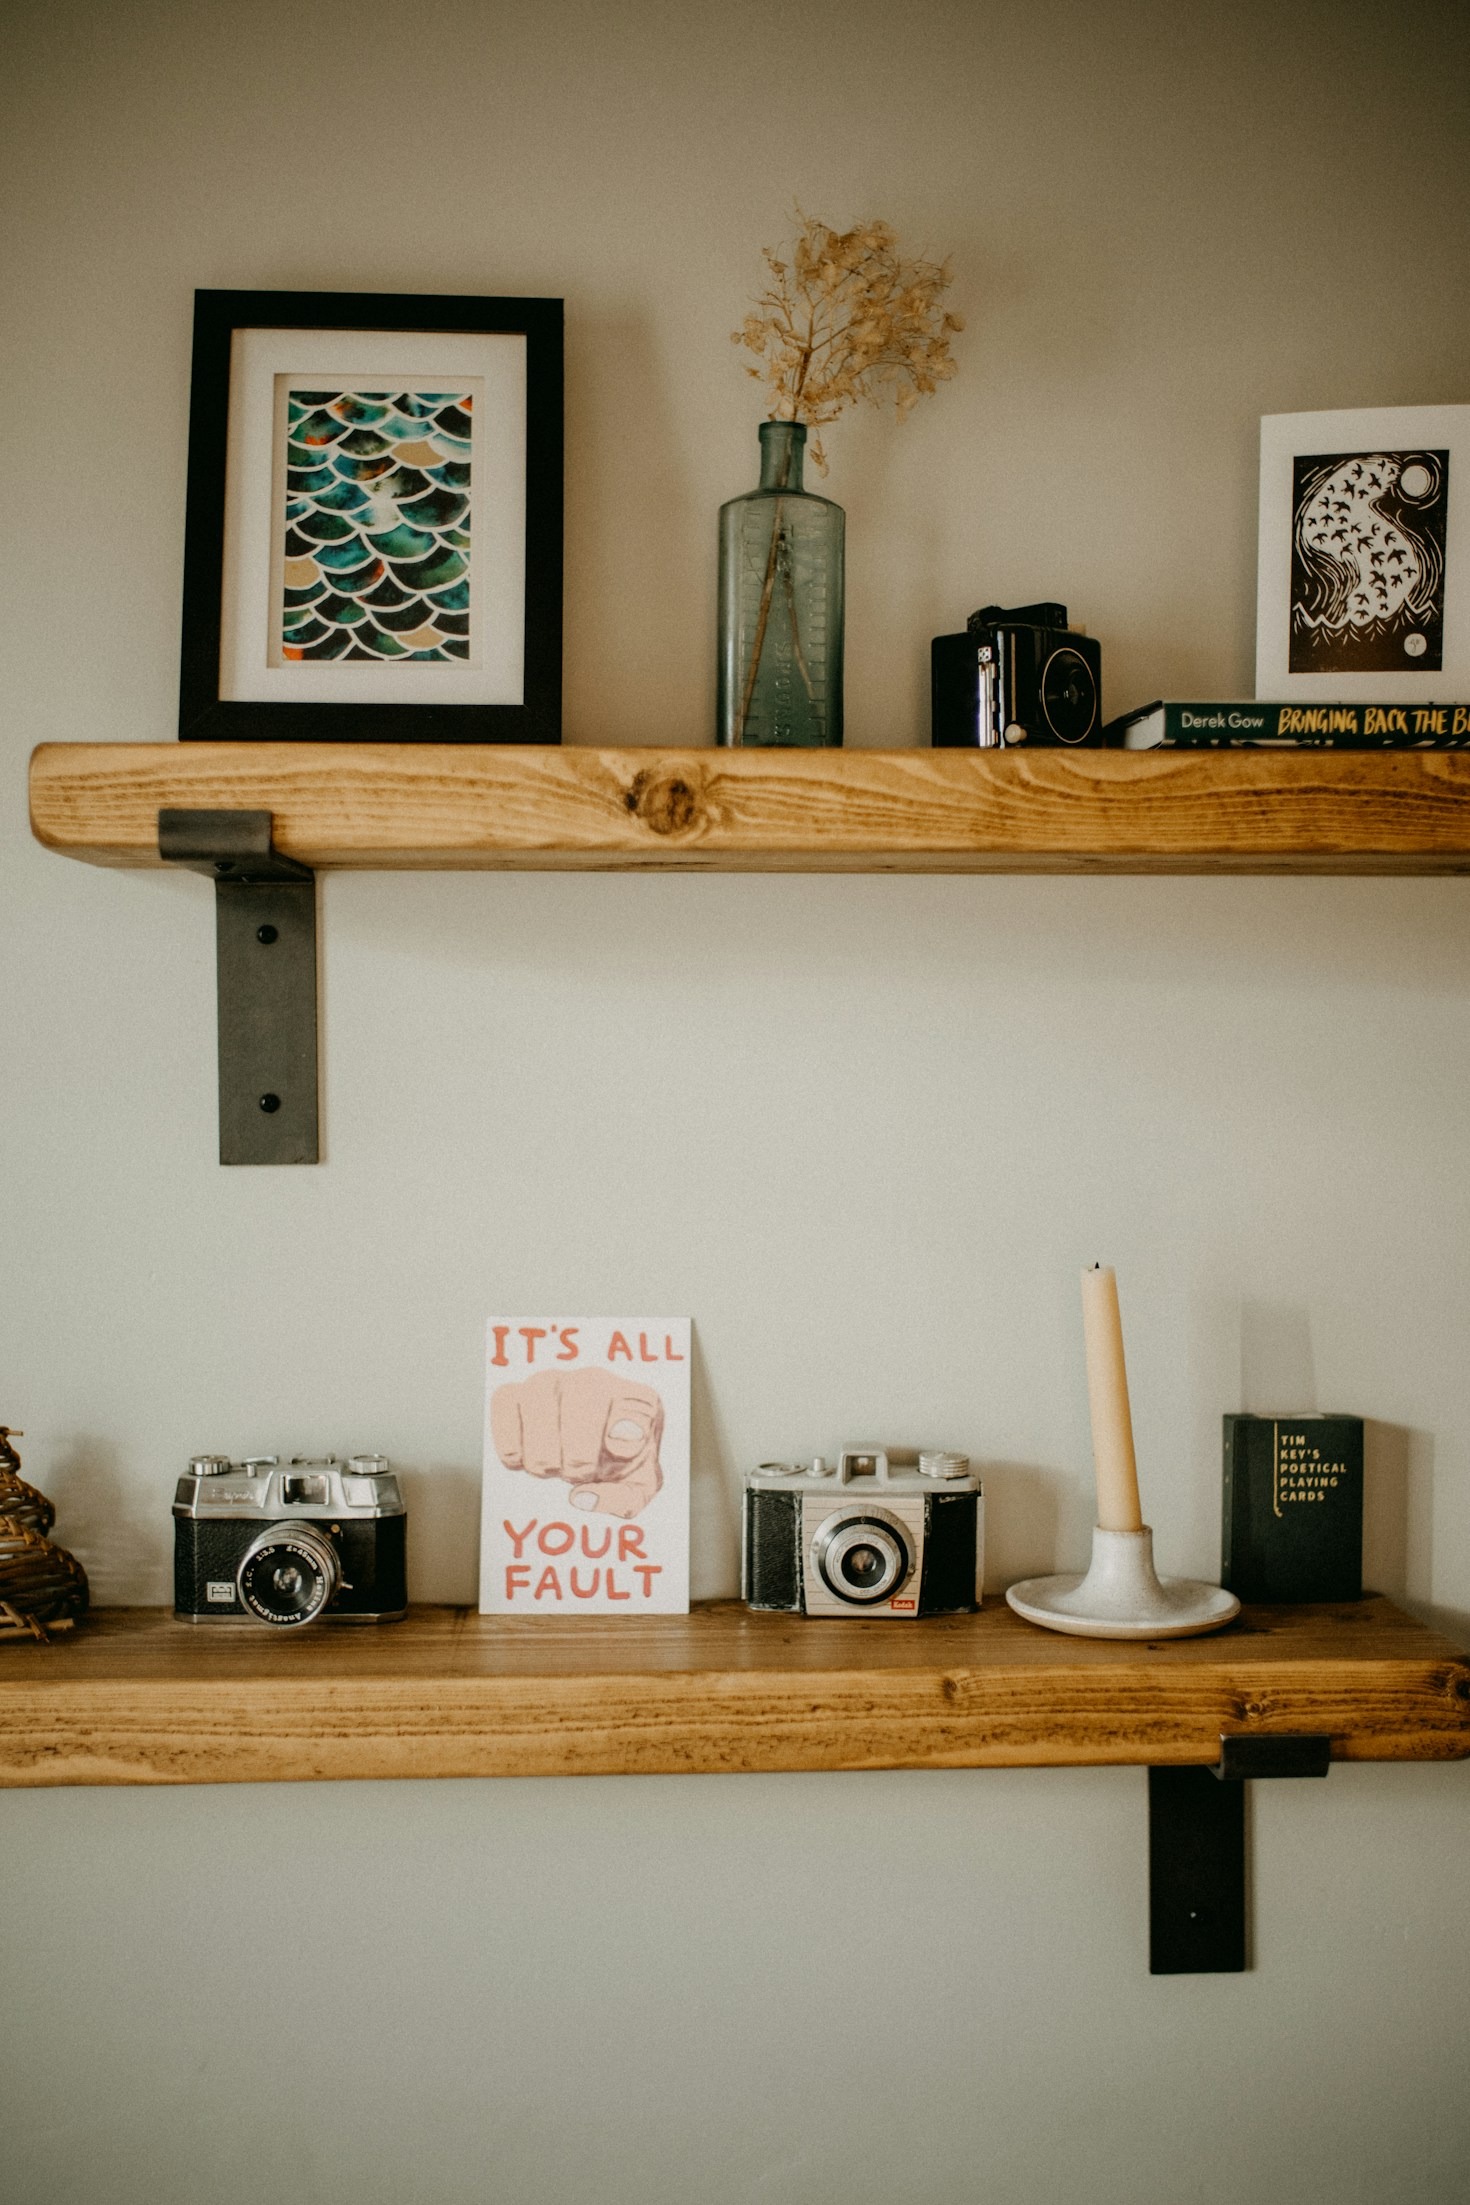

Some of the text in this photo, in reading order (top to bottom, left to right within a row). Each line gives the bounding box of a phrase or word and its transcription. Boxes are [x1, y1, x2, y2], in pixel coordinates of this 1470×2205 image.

[1181, 711, 1264, 729] Derek Gow
[1278, 706, 1470, 736] BRINGING BACK THE B
[491, 1325, 684, 1366] IT'S ALL
[1280, 1435, 1306, 1446] TIM
[1280, 1449, 1320, 1460] KEY'S
[1280, 1463, 1347, 1473] POETICAL
[1280, 1477, 1339, 1487] PLAYING
[1280, 1491, 1325, 1501] CARDS
[503, 1518, 648, 1562] YOUR
[505, 1565, 663, 1600] FAULT
